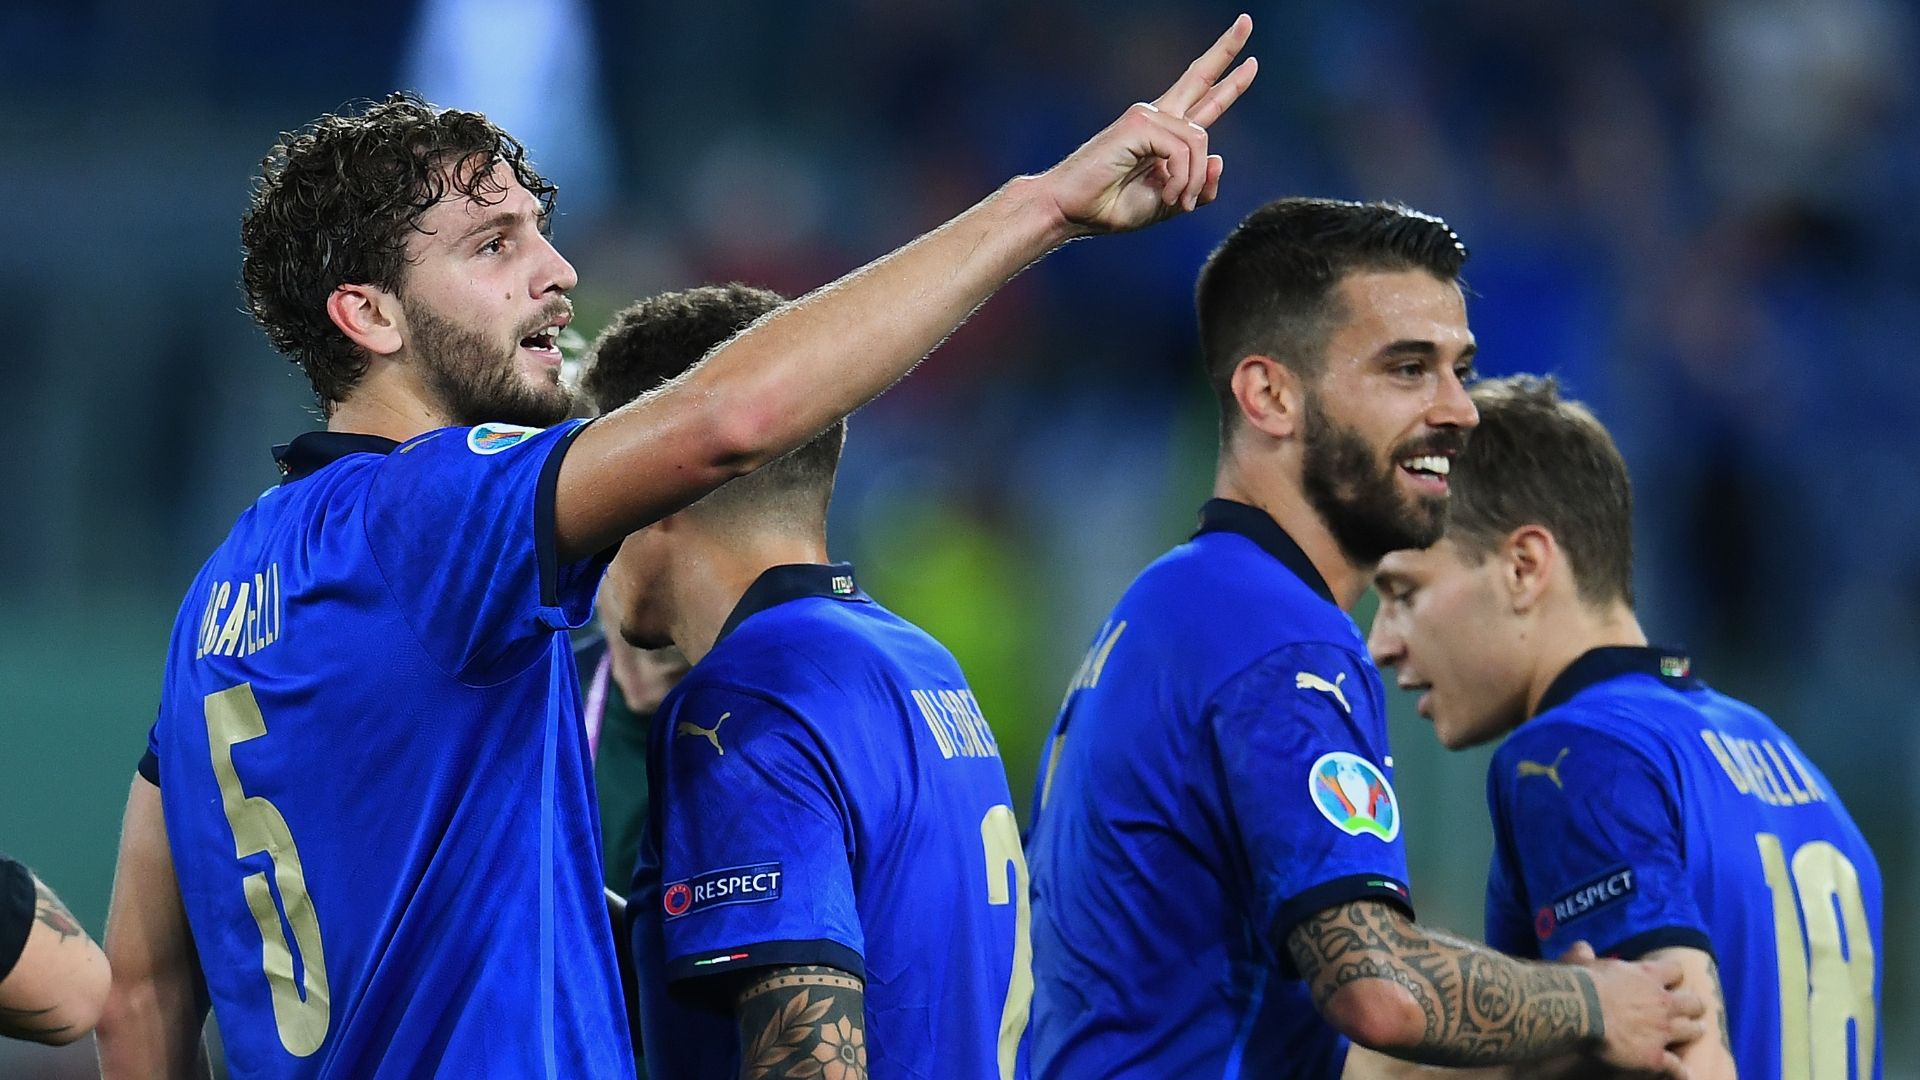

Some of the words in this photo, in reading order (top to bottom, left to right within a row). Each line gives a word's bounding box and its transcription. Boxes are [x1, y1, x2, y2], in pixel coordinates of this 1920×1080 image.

[196, 562, 280, 660] LOCAELLI
[1700, 729, 1827, 807] BELLA
[203, 682, 331, 1057] 5
[695, 872, 781, 903] RESPECT
[1554, 870, 1632, 923] RESPECT
[980, 804, 1035, 1080] 2
[1755, 831, 1876, 1080] 18
